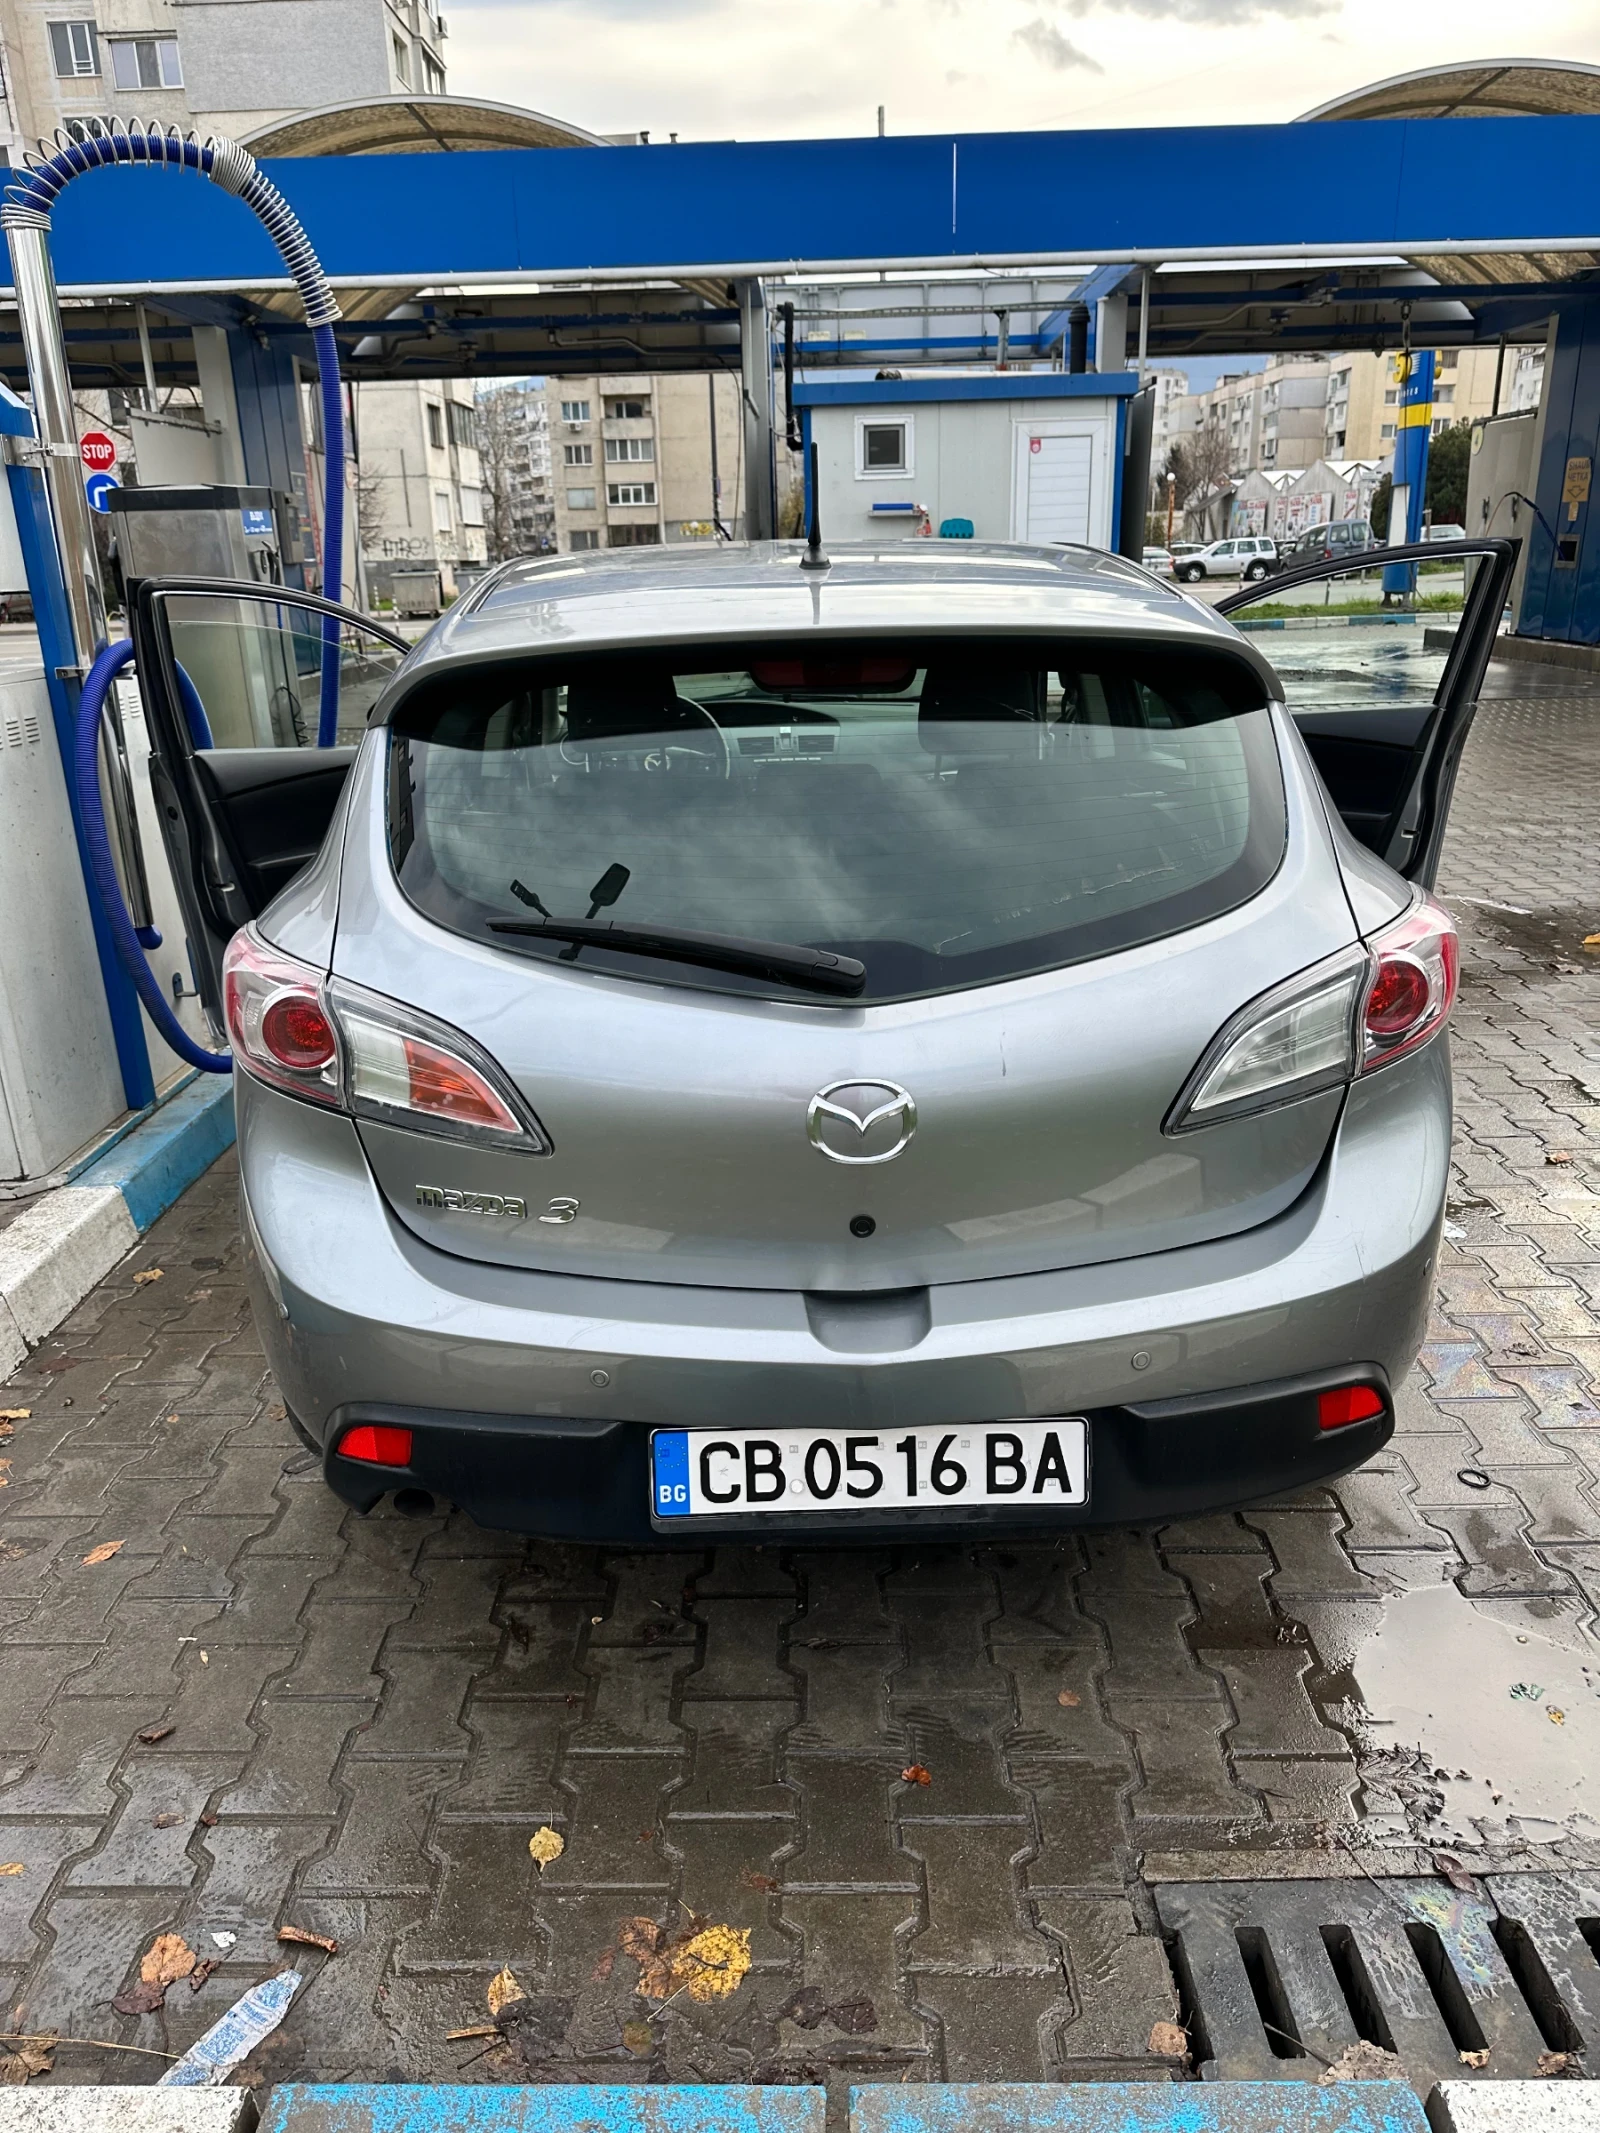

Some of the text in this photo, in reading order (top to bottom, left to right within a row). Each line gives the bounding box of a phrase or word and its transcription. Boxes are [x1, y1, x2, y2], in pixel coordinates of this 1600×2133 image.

[82, 444, 112, 459] STOP
[415, 1184, 581, 1224] mazda 3
[699, 1431, 1073, 1503] CB 0516 BA
[659, 1484, 687, 1504] BG
